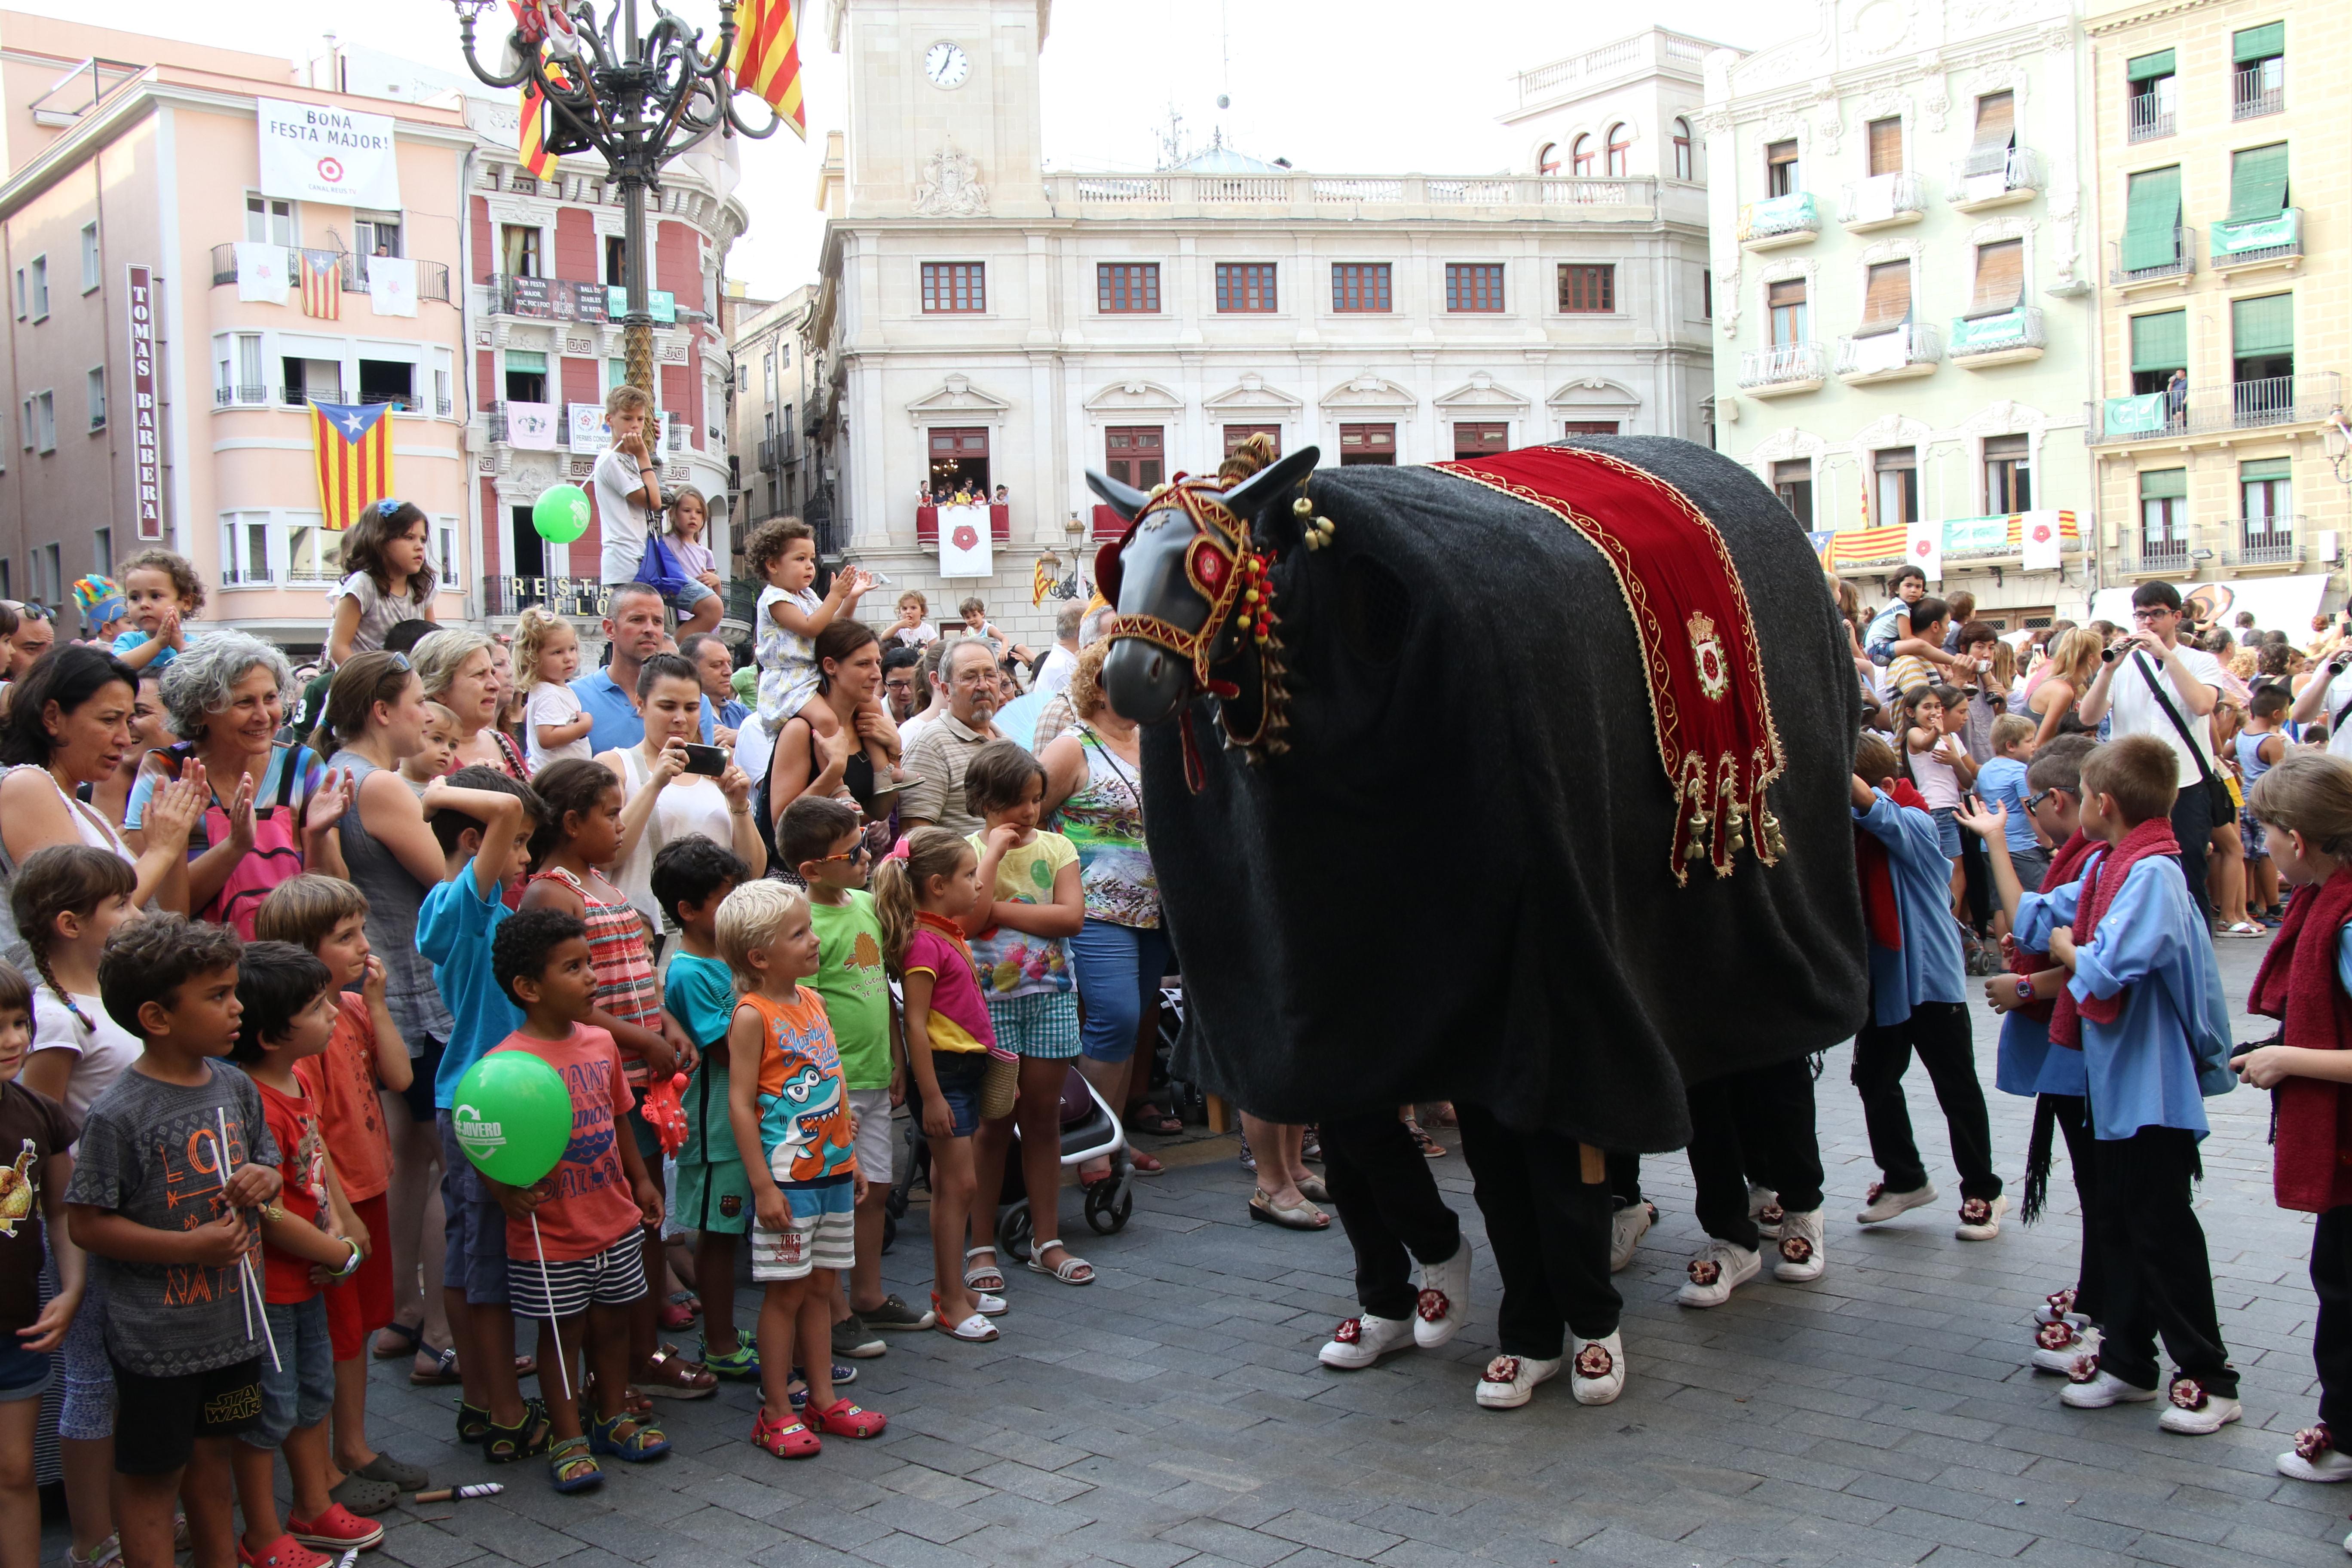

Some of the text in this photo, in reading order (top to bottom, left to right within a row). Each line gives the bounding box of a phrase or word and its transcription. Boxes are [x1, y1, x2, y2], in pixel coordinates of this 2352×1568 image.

[307, 110, 352, 130] BONA
[270, 120, 388, 150] FESTA MAJOR!
[308, 184, 329, 193] CANAL
[133, 286, 150, 377] TOMÀS
[137, 392, 157, 519] BARBERÀ
[293, 699, 307, 724] 3
